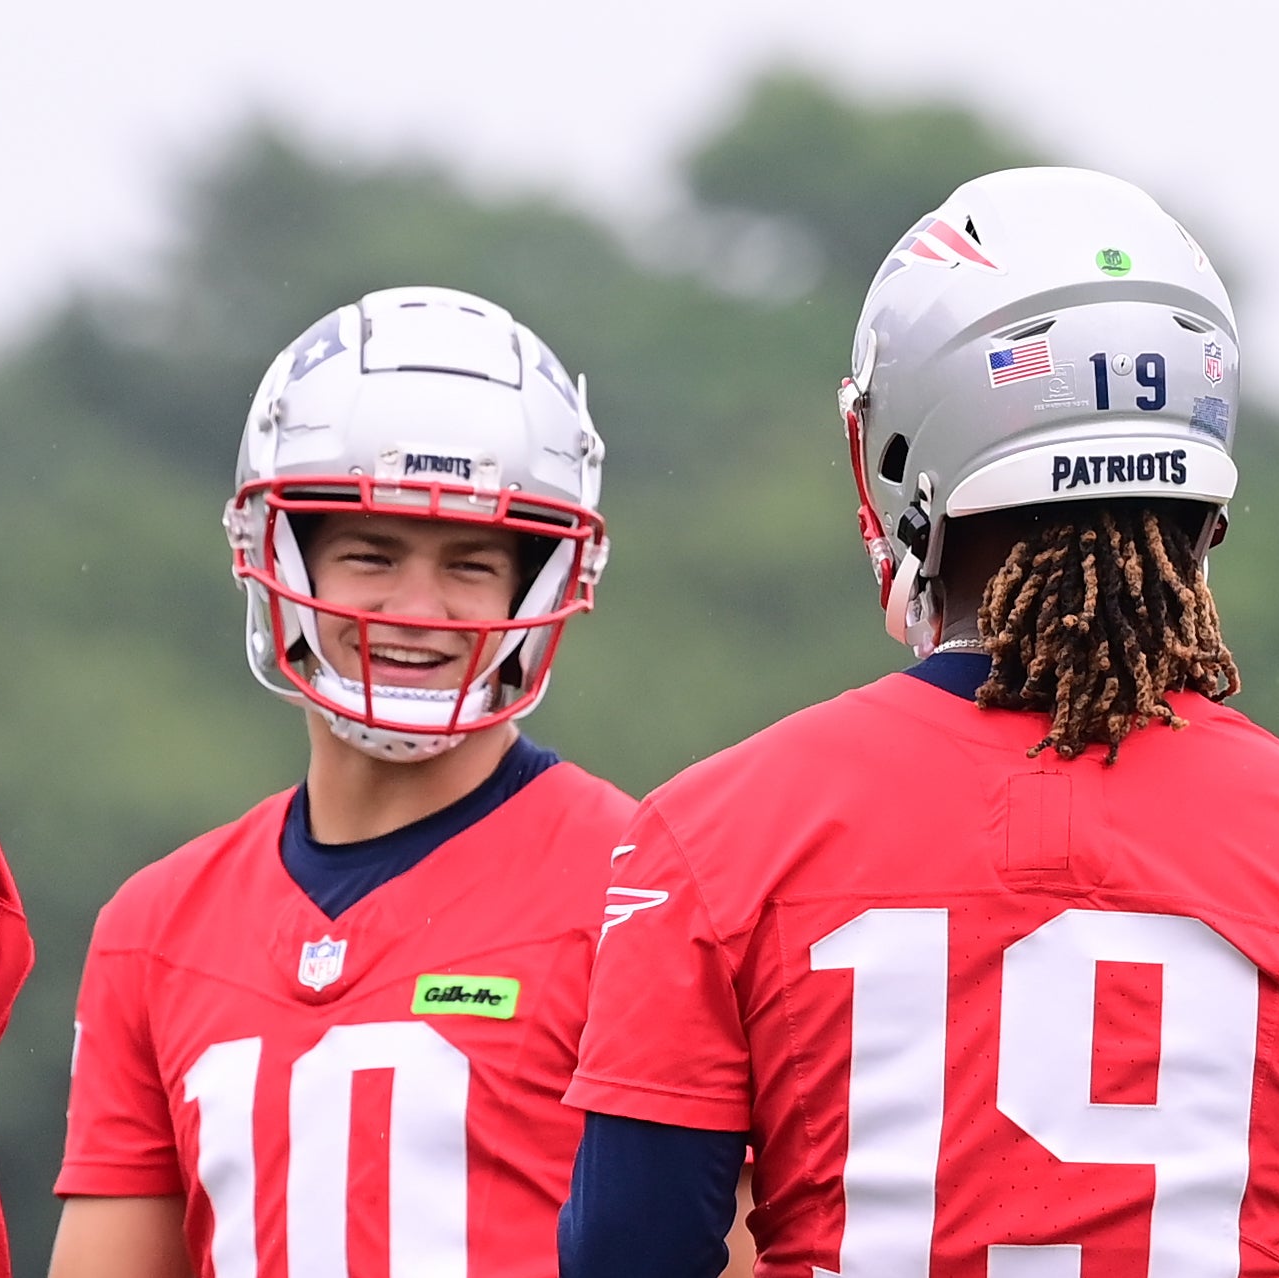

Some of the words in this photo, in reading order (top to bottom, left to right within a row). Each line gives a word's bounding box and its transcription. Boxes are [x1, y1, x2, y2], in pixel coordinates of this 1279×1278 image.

[1089, 353, 1166, 410] 19
[1206, 359, 1222, 380] NFL
[404, 453, 471, 480] PATRIOTS
[1052, 449, 1187, 492] PATRIOTS
[309, 960, 334, 980] NFL
[424, 985, 503, 1006] Gillette
